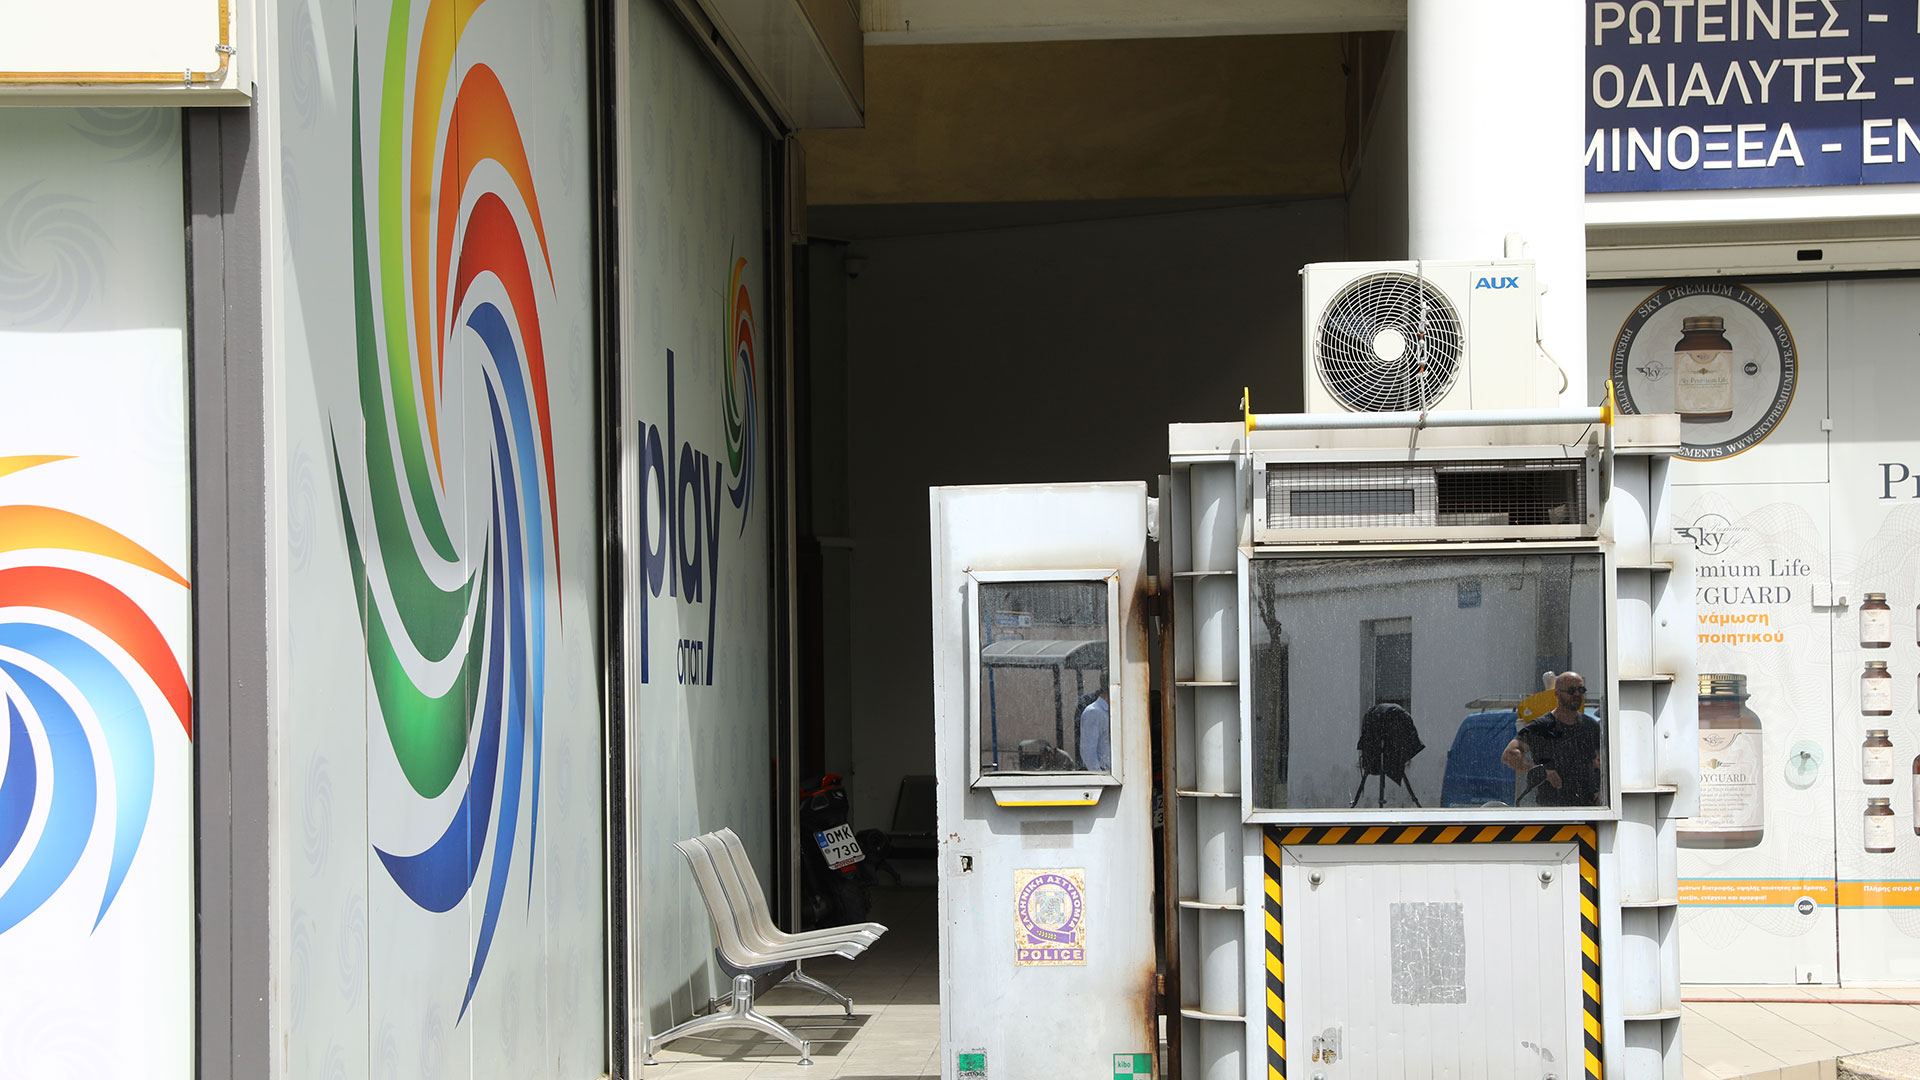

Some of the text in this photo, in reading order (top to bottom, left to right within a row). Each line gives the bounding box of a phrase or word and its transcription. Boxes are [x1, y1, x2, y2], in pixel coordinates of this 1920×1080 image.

[1592, 55, 1876, 109] ΟΔΙΑΛΥΤΕΣ
[1475, 277, 1519, 289] AUX
[1638, 283, 1769, 318] SKY PREMIUM LIFE
[1614, 328, 1634, 379] PREMIUM
[1616, 381, 1635, 415] NUTRI
[1726, 324, 1794, 454] WWW.SKYPREMIUMLIFE.COM
[638, 348, 723, 686] play
[1674, 527, 1724, 552] Sky
[1769, 559, 1811, 577] Life
[1698, 612, 1769, 627] νάμωση
[1698, 630, 1784, 646] ποιητικού
[832, 842, 860, 859] 730
[1019, 876, 1080, 930] ΕΛΛΗΝΙΚΗ ΑΣΤΥΝΟΜΙΑ
[1020, 950, 1082, 960] POLICE
